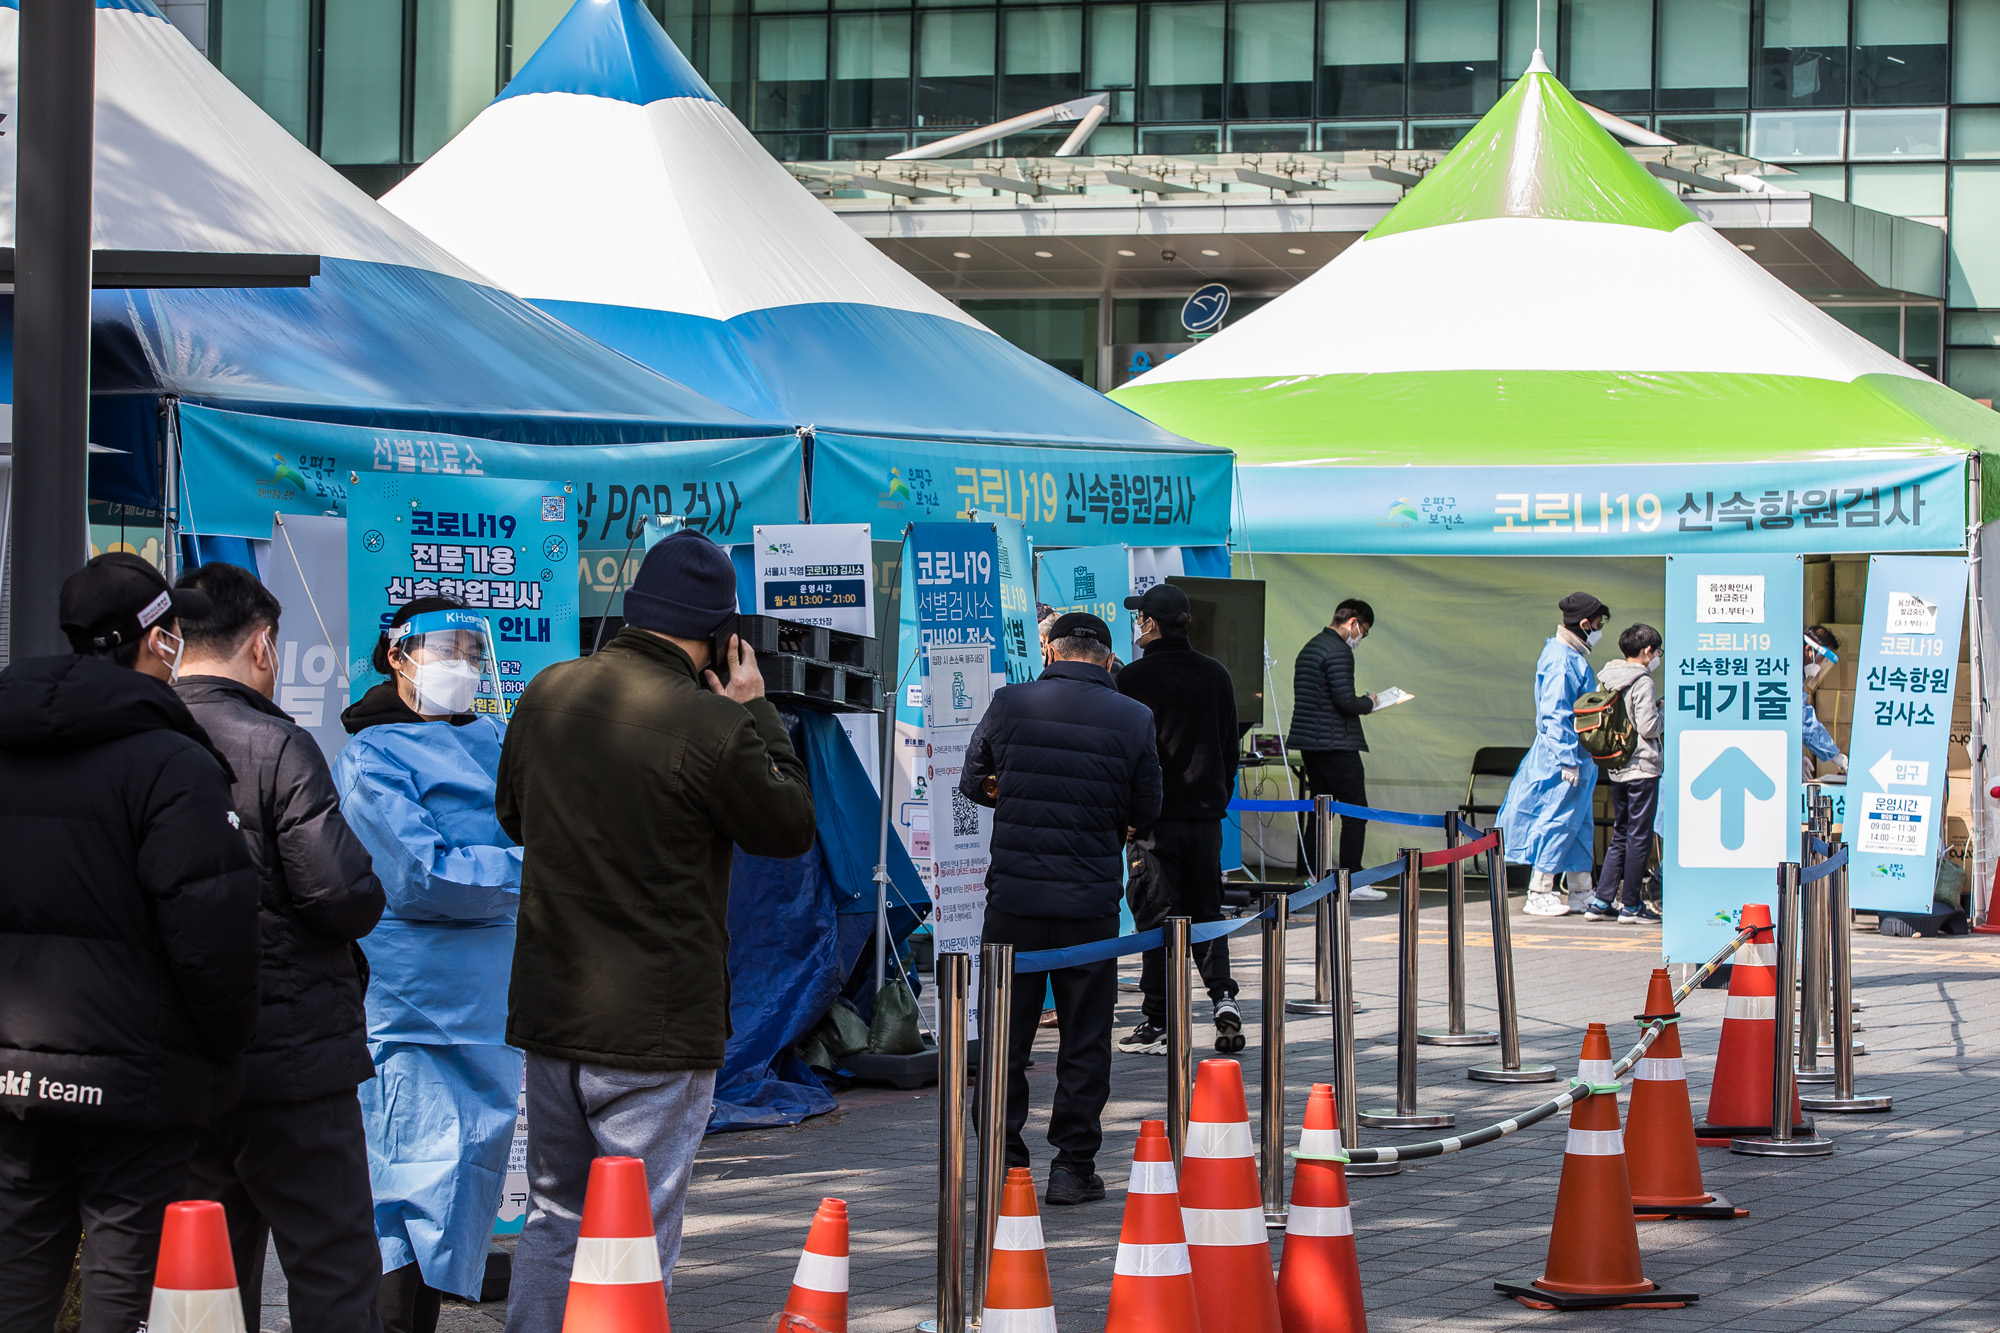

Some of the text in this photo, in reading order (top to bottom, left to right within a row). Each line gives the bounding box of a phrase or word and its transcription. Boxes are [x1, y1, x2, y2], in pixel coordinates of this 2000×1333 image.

[298, 455, 336, 480] 은평구
[373, 437, 484, 475] 선별진료소
[908, 466, 1196, 525] 은평구 코로나19 신속항원검사
[916, 491, 940, 515] 보건소
[682, 481, 742, 536] 검사
[1421, 483, 1926, 534] 은평구 코로나19 신속항원검사
[411, 511, 517, 539] 코로나19
[1428, 513, 1465, 530] 보건소
[410, 543, 517, 575] 전문가용
[764, 565, 863, 576] 서울시 직영 코로나19 검사소
[917, 551, 991, 585] 코로나19
[800, 584, 832, 593] 운영시간
[1710, 583, 1753, 592] 음성확인서
[1715, 594, 1748, 602] 발급중단
[774, 595, 797, 607] 월~일
[799, 595, 823, 605] 13:00
[832, 594, 856, 604] 21:00
[918, 591, 994, 622] 선별검사소
[499, 616, 551, 642] 안내
[1697, 633, 1771, 651] 코로나19
[1879, 636, 1944, 657] 코로나19
[500, 660, 523, 675] 달간
[1679, 658, 1790, 676] 신속항원 검사
[1866, 666, 1950, 694] 신속항원
[1678, 681, 1791, 720] 대기줄
[1874, 700, 1935, 727] 검사소
[1896, 764, 1920, 781] 입구
[1875, 797, 1918, 813] 운영시간
[1871, 822, 1891, 831] 09:00
[1898, 824, 1917, 832] 11:30
[1871, 833, 1890, 842] 14:00
[1897, 835, 1916, 844] 17:30
[39, 1077, 103, 1105] team
